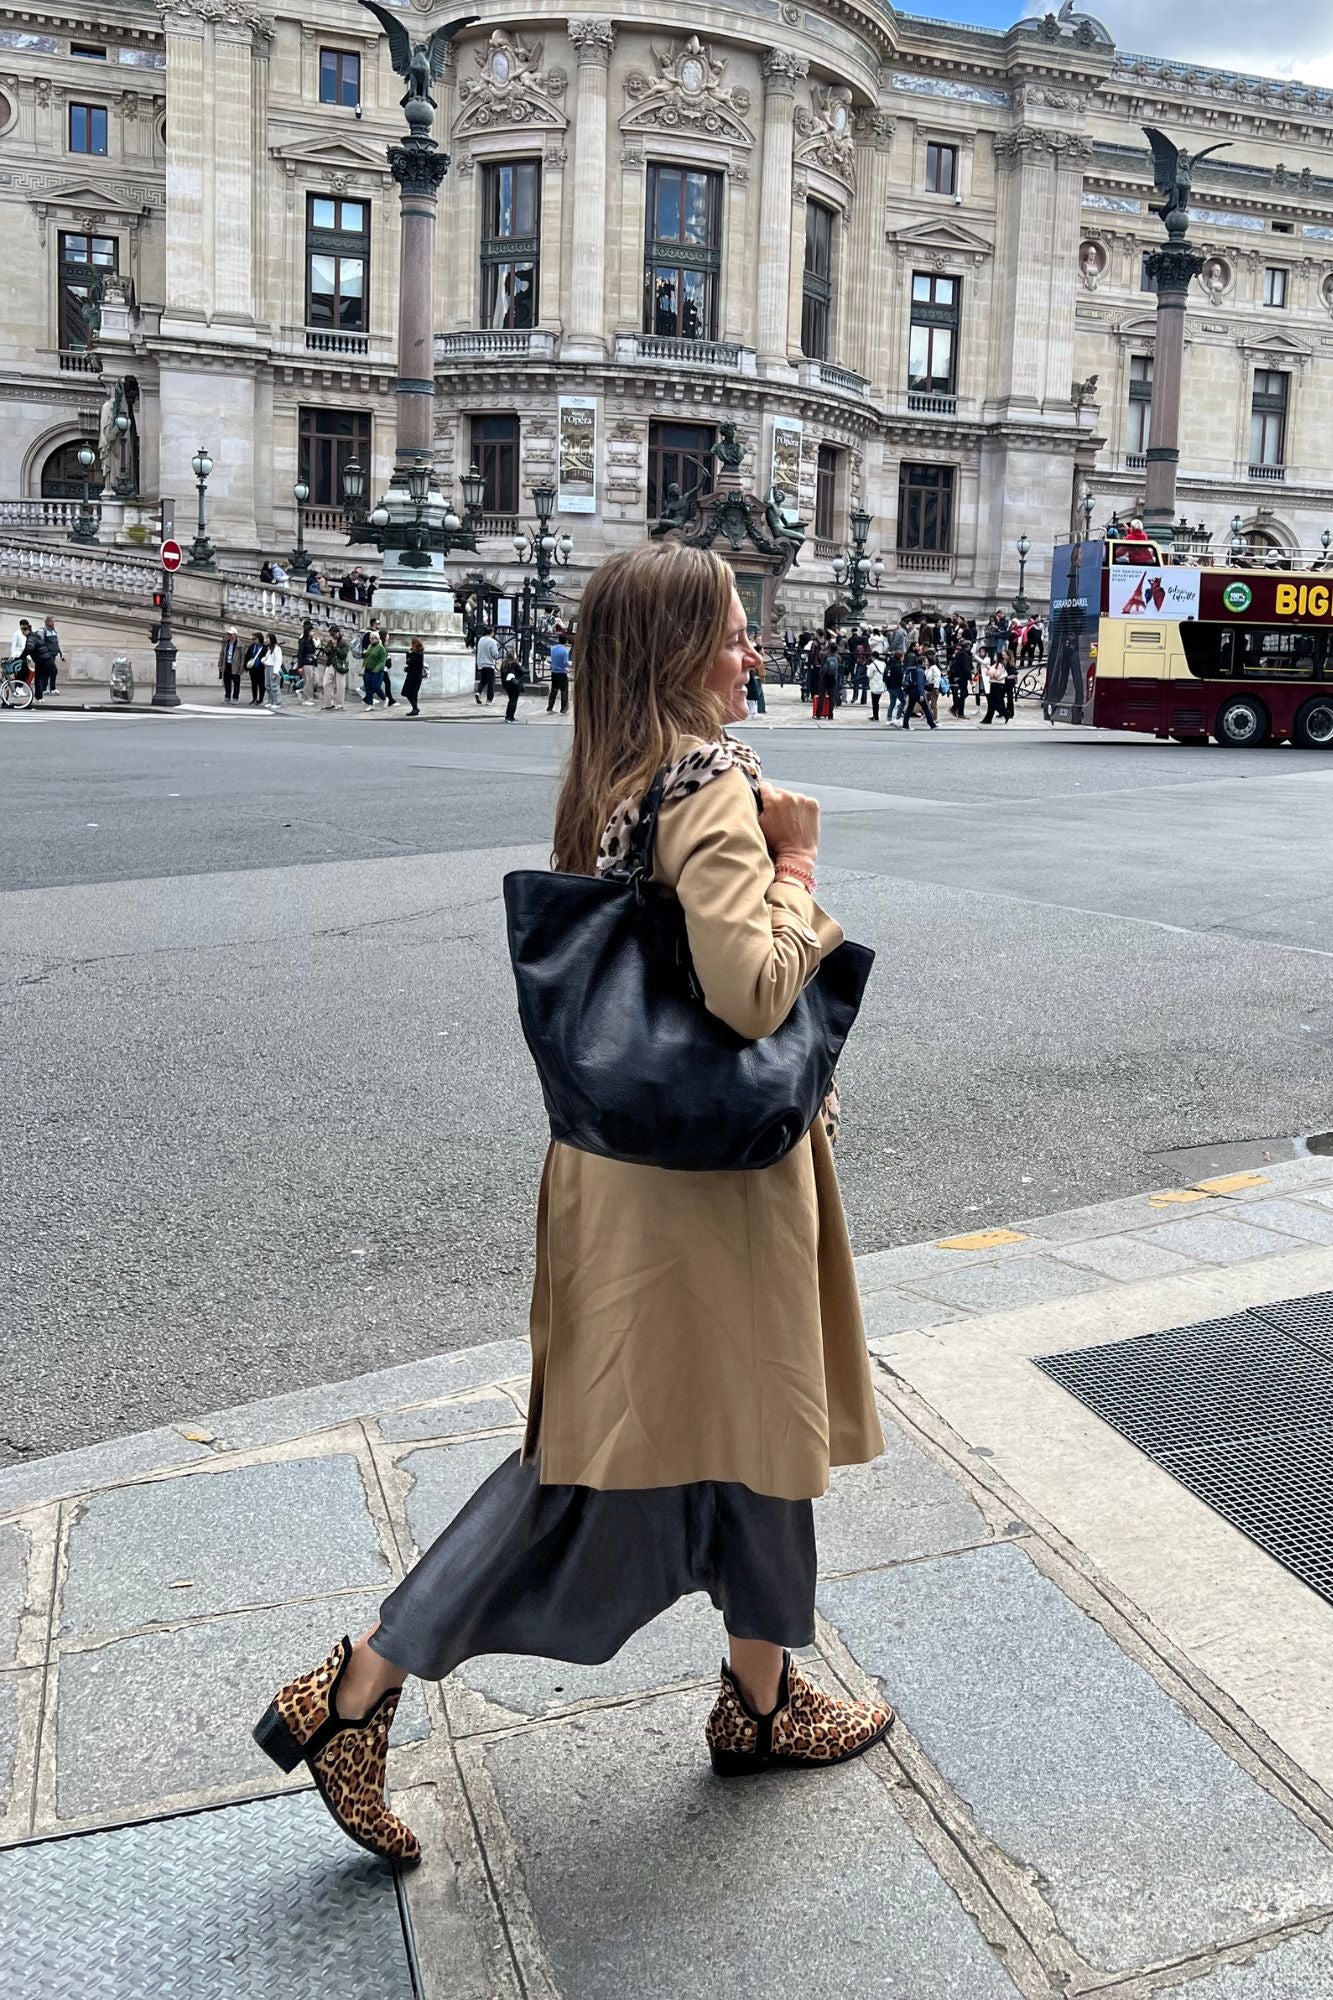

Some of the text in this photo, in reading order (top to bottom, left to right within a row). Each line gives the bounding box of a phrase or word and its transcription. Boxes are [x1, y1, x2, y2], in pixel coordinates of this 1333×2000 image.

[1053, 597, 1088, 608] GERARD DAREL
[1275, 583, 1333, 616] BIG
